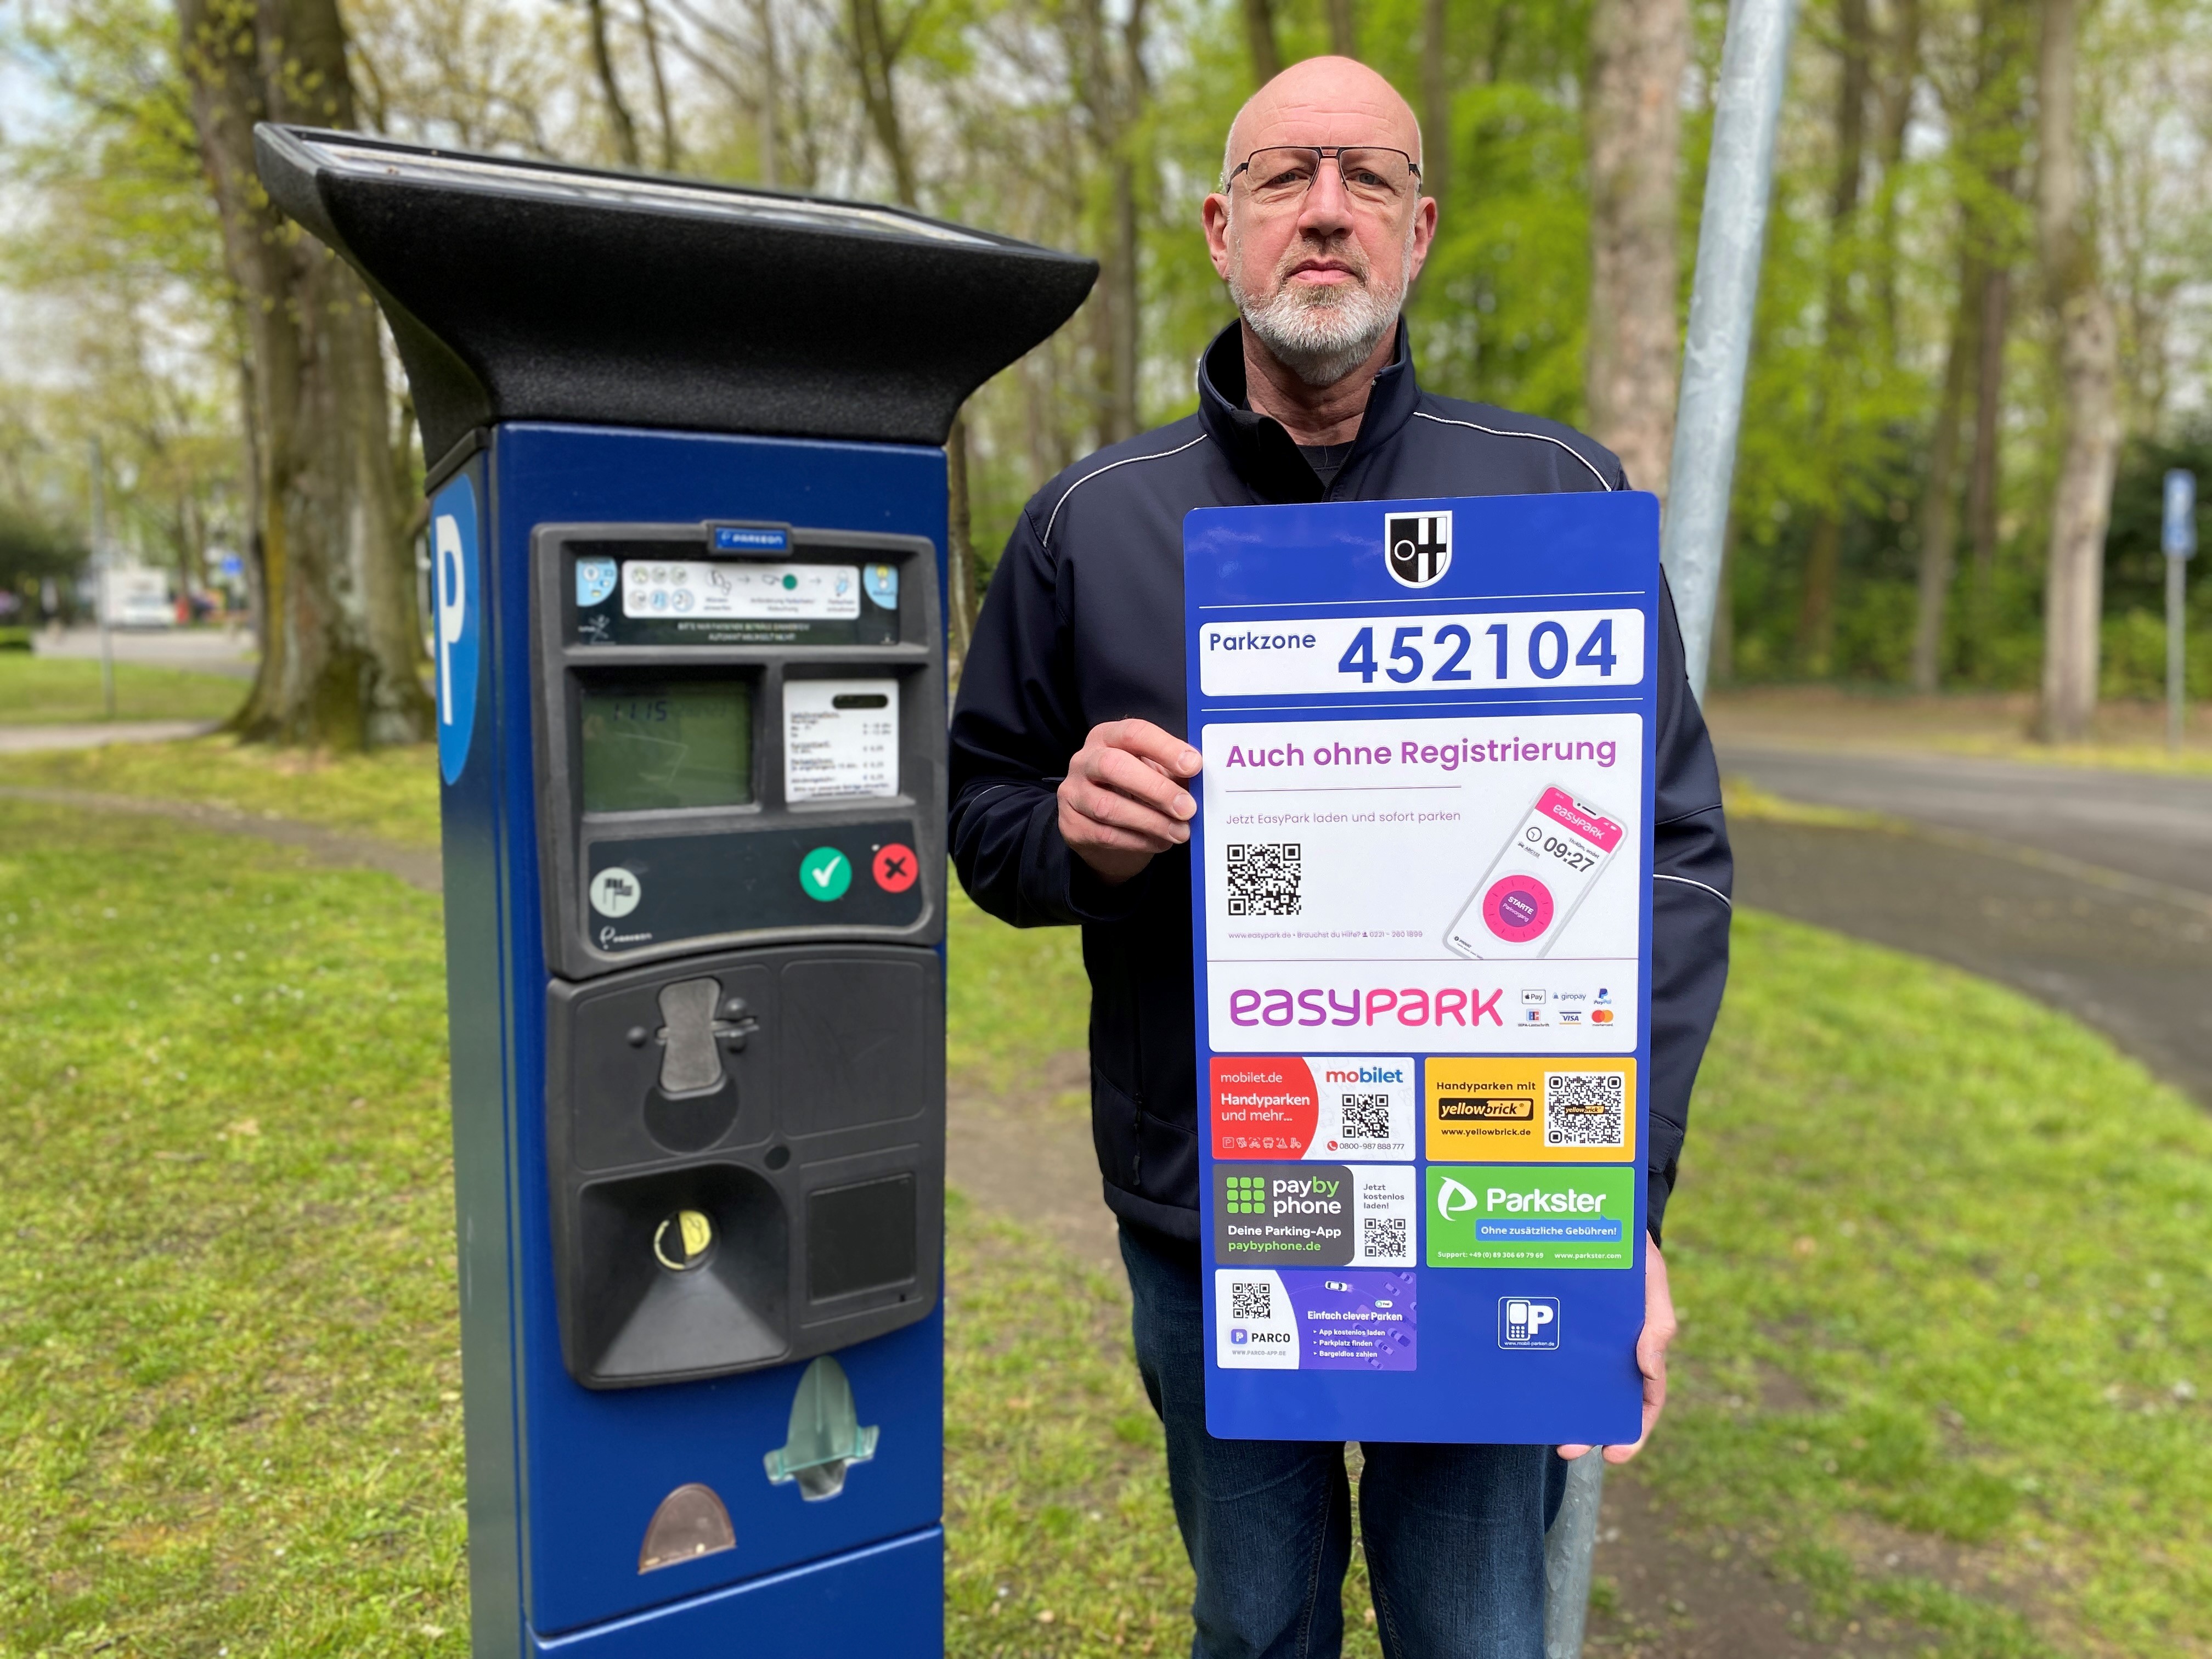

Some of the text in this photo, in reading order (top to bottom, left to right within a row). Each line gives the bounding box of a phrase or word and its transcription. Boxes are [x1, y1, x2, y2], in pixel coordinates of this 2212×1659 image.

[436, 515, 465, 725] P
[1210, 619, 1617, 684] Parkzone 452104
[1226, 736, 1617, 771] Auch ohne Registrierung
[1226, 810, 1460, 826] Jetzt EasyPark laden und sofort parken
[1544, 837, 1595, 872] 09:27
[1502, 903, 1530, 922] Parkvorgang
[1508, 896, 1534, 915] STARTE
[1228, 932, 1291, 940] www.easypark.de
[1561, 992, 1587, 1001] giropay
[1221, 1071, 1283, 1083] mobilet.de
[1325, 1067, 1403, 1083] mobilet
[1436, 1082, 1536, 1092] Handyparken mit
[1221, 1093, 1310, 1108] Handyparken
[1221, 1109, 1293, 1121] und mehr...
[1441, 1128, 1531, 1137] www.yellowbrick.de
[1273, 1176, 1339, 1198] payby
[1273, 1197, 1341, 1217] phone
[1487, 1188, 1606, 1212] Parkster
[1228, 1226, 1341, 1239] Deine Parking-App
[1481, 1226, 1617, 1235] Ohne zusätzliche Gebühren!
[1228, 1241, 1321, 1252] paybyphone.de
[1437, 1251, 1468, 1260] Support:
[1307, 1311, 1403, 1321] Einfach clever Parken
[1528, 1305, 1553, 1334] P
[1251, 1333, 1290, 1343] PARCO
[1319, 1350, 1355, 1358] Bargeldlos
